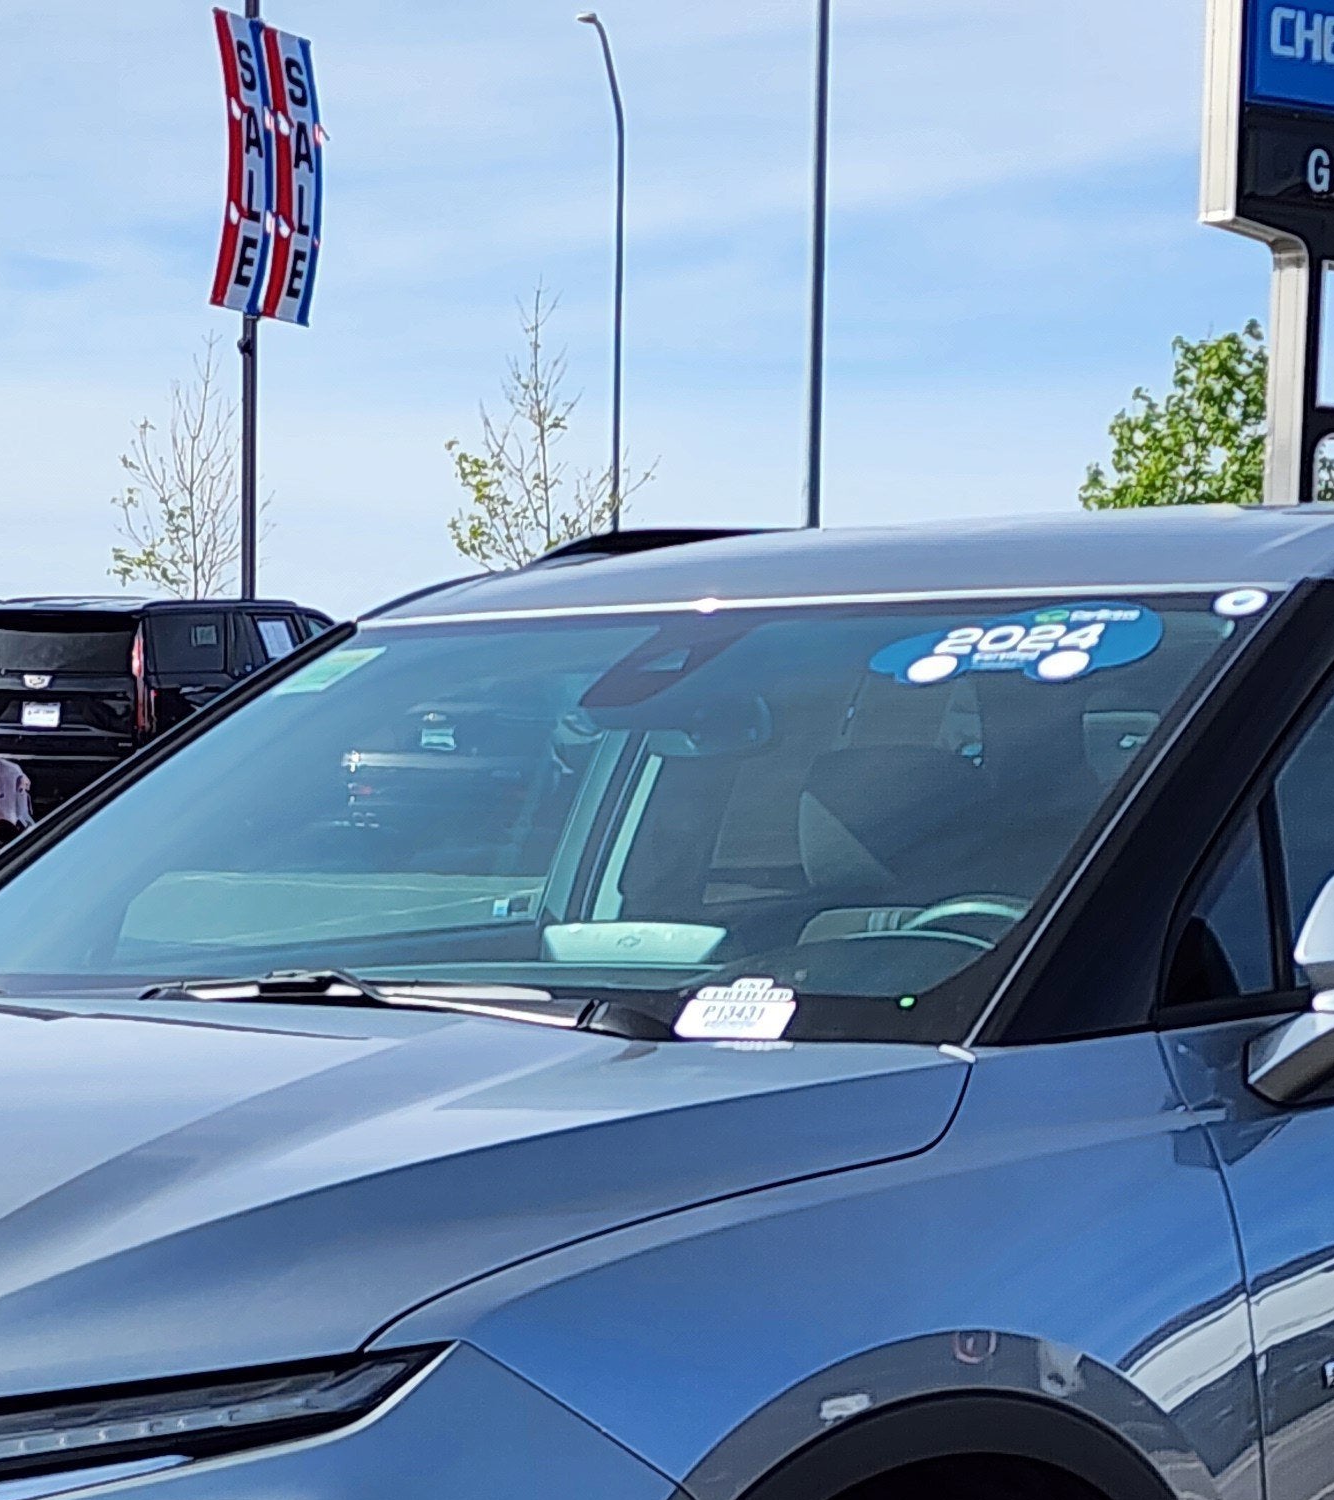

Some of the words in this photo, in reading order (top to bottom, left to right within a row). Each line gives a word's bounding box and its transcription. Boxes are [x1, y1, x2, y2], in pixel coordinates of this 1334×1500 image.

[234, 40, 263, 287] SALE
[285, 56, 314, 299] SALE
[934, 623, 1105, 655] 2024
